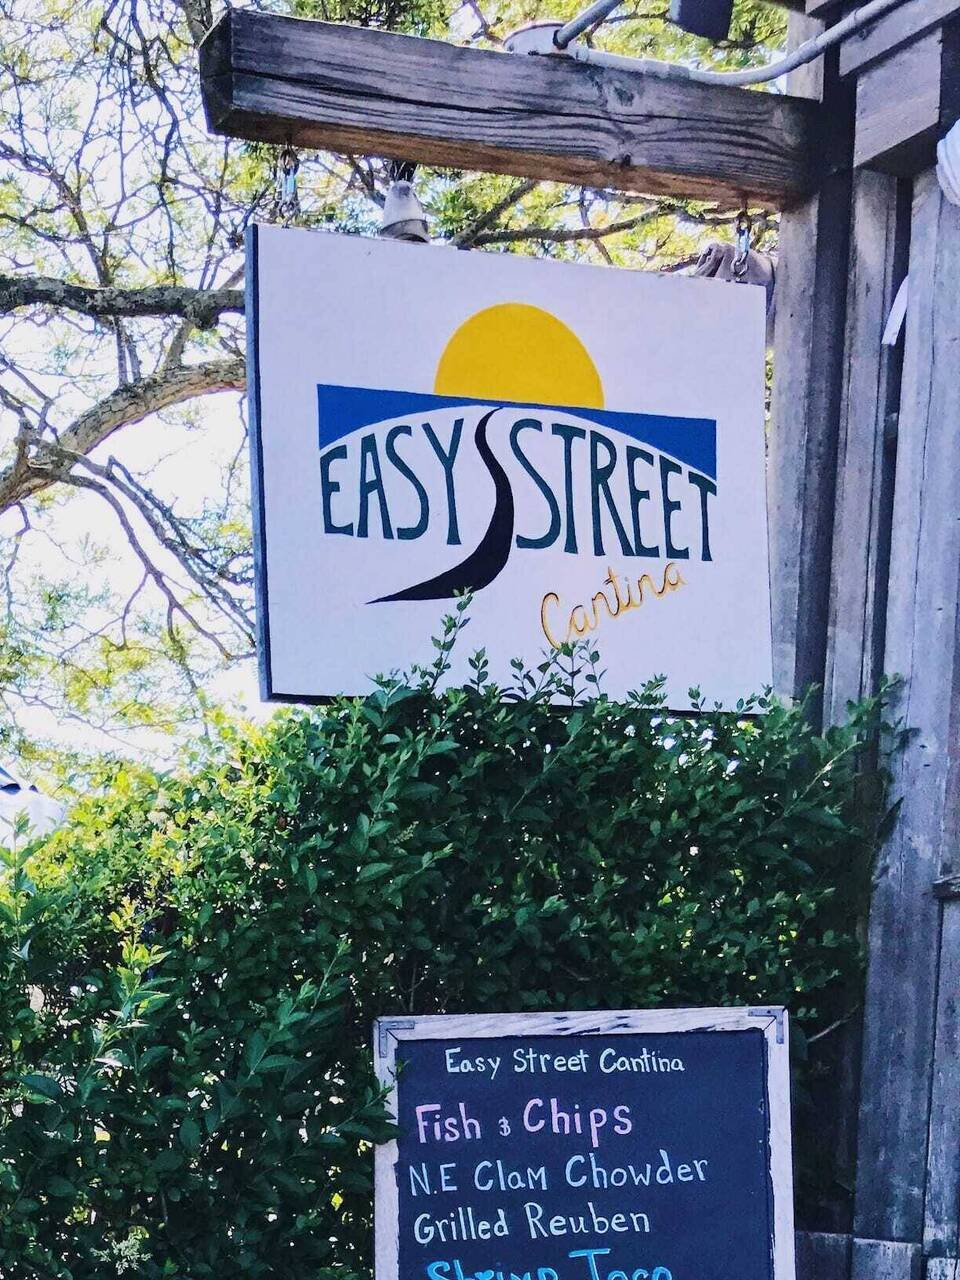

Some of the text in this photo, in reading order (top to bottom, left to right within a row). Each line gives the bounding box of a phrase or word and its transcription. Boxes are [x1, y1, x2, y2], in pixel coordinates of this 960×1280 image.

[319, 417, 718, 562] EASY STREET
[539, 562, 688, 649] Cantina
[445, 1047, 685, 1079] Easy Street Cantina
[415, 1102, 482, 1143] Fish
[523, 1098, 632, 1148] Chips
[565, 1149, 709, 1189] Chowder
[414, 1202, 650, 1244] Grilled Reuben
